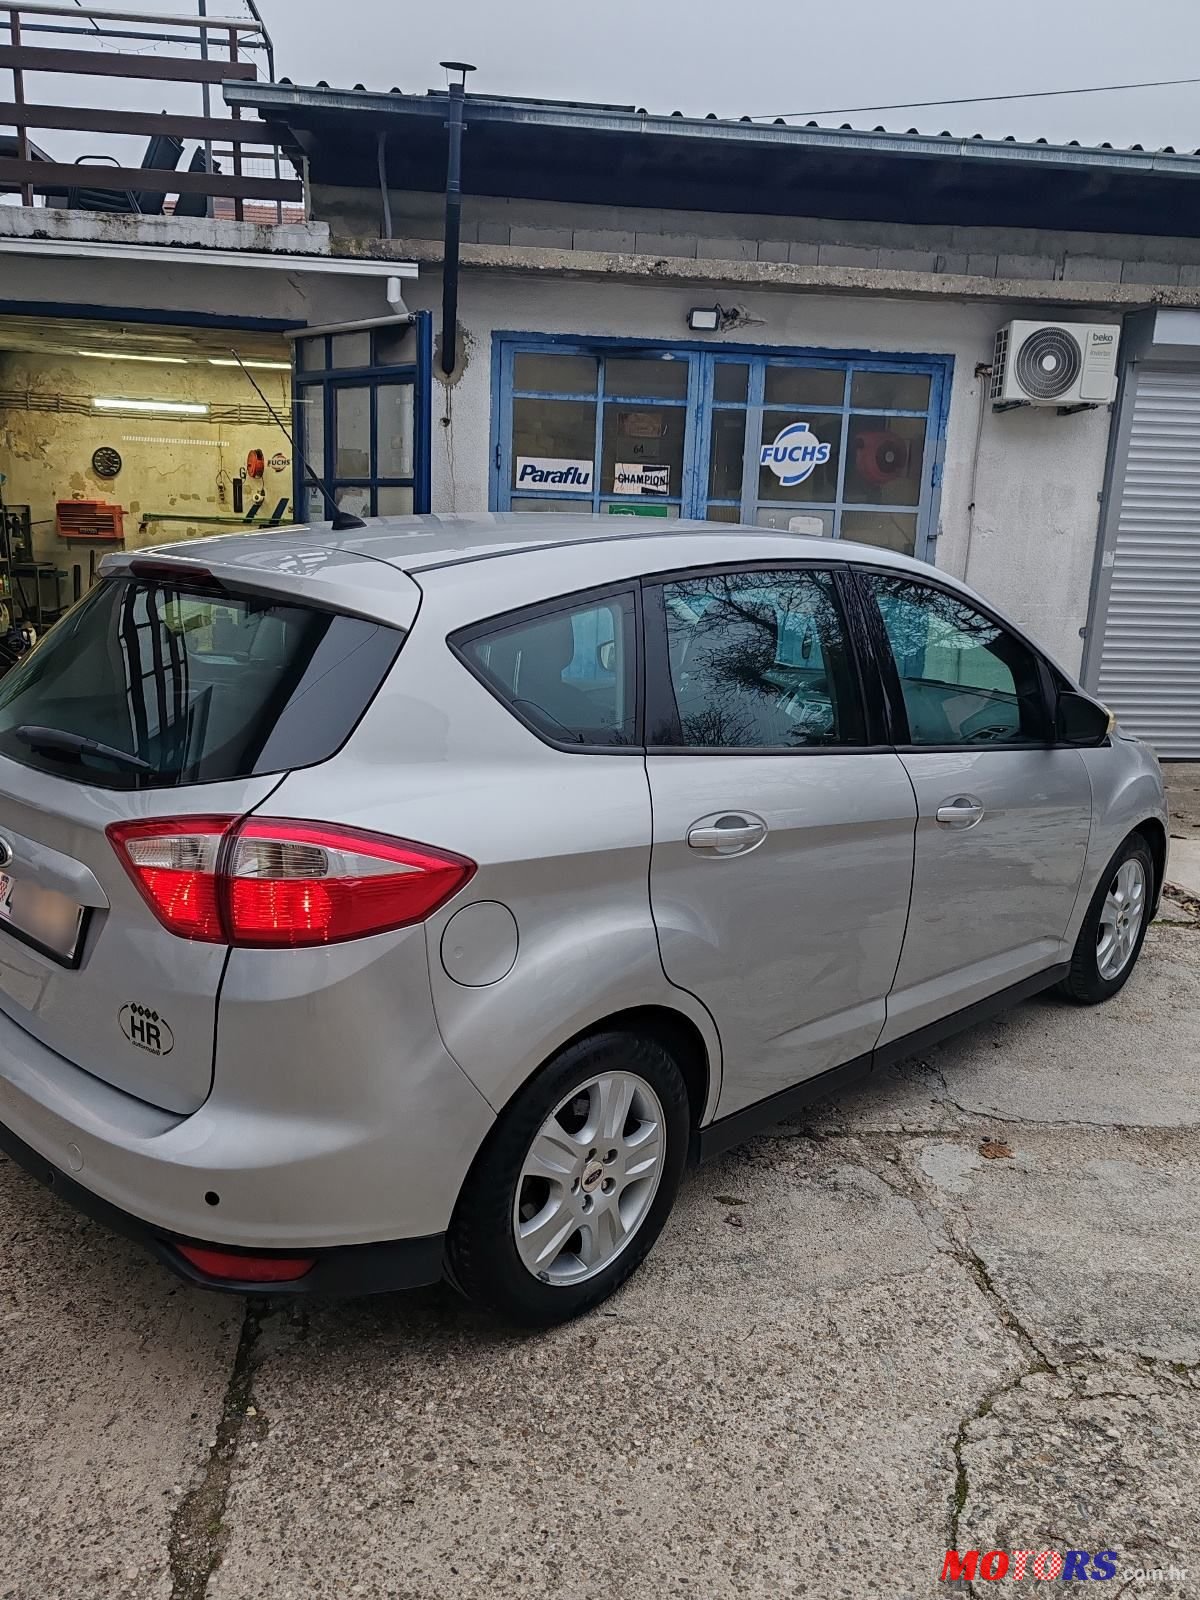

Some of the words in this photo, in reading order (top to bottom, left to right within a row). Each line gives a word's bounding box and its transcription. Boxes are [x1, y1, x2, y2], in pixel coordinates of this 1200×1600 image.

[1092, 332, 1114, 342] beko
[760, 445, 828, 463] FUCHS
[267, 459, 291, 468] FUCHS
[518, 464, 591, 485] Paraflu
[617, 473, 667, 488] CHAMPION
[130, 1015, 161, 1050] HR
